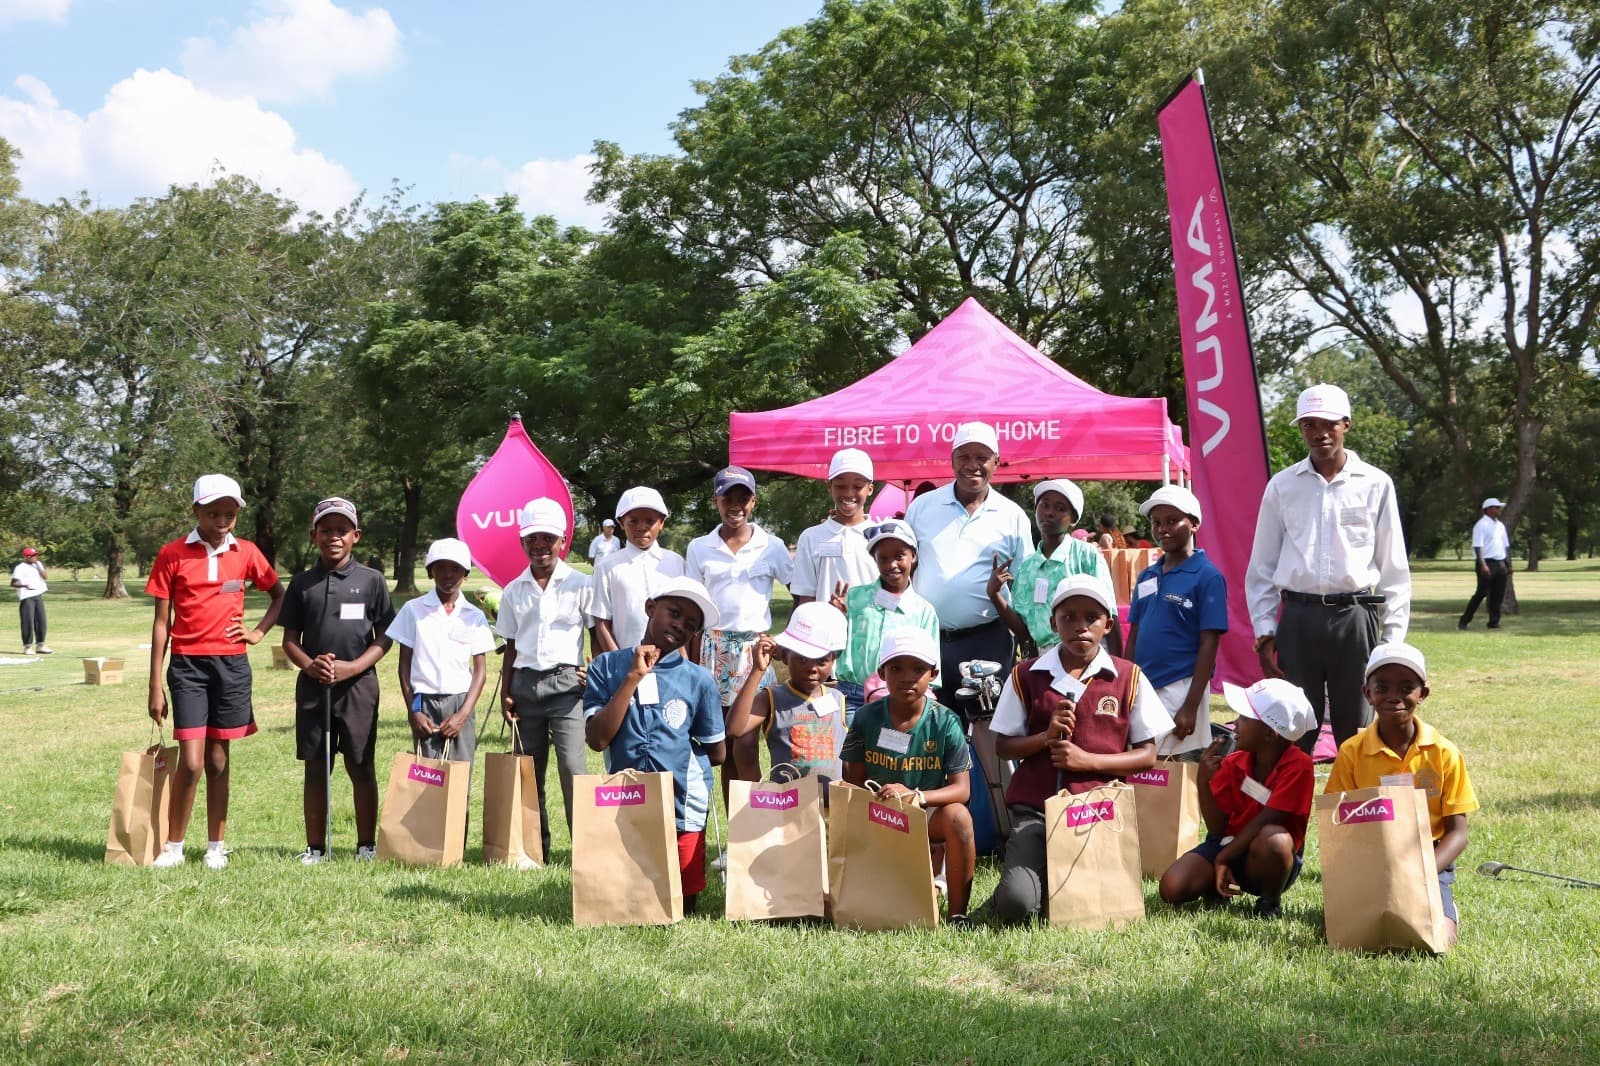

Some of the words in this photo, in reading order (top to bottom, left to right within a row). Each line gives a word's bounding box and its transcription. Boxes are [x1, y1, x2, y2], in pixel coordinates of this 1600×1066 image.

[1213, 211, 1226, 265] COMPANY
[1187, 196, 1231, 458] VUMA
[824, 425, 886, 448] FIBRE
[892, 424, 920, 445] TO
[927, 422, 961, 443] YO
[996, 420, 1061, 441] HOME
[472, 508, 524, 529] VU
[865, 750, 898, 771] SOUTH
[901, 755, 942, 772] AFRICA
[413, 768, 442, 782] VUMA
[600, 790, 641, 801] VUMA
[756, 795, 795, 806] VUMA
[872, 808, 905, 827] VUMA
[1072, 807, 1109, 820] VUMA
